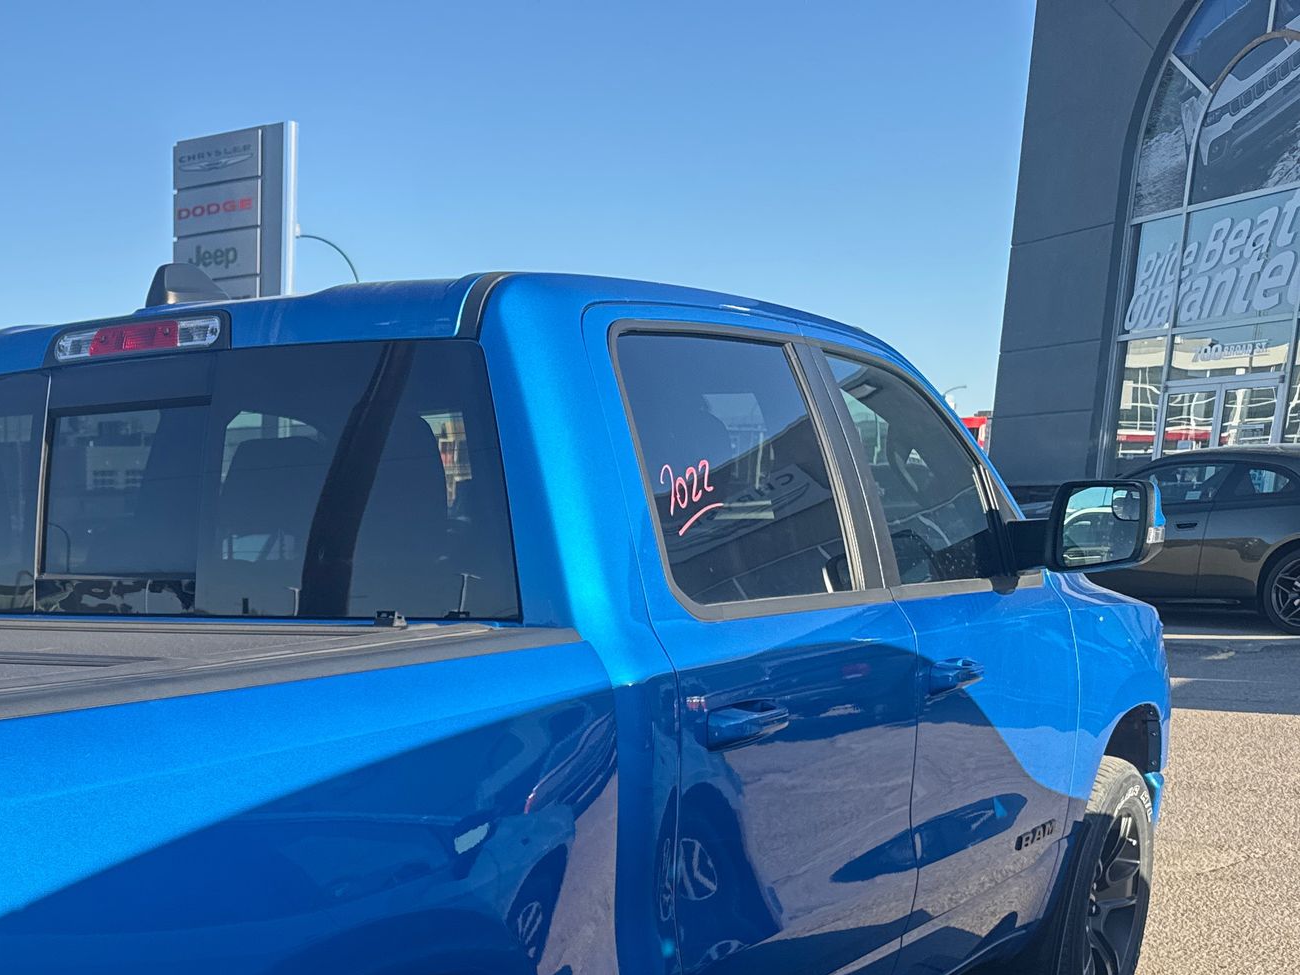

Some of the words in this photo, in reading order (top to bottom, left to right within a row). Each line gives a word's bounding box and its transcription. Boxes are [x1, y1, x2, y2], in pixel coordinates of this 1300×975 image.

[178, 143, 252, 164] CHRYSLER
[177, 197, 253, 220] DODGE
[188, 245, 238, 269] Jeep
[1136, 241, 1200, 287] Price
[1125, 251, 1300, 330] Guarante
[660, 459, 714, 516] 2022
[1014, 819, 1057, 851] RAM
